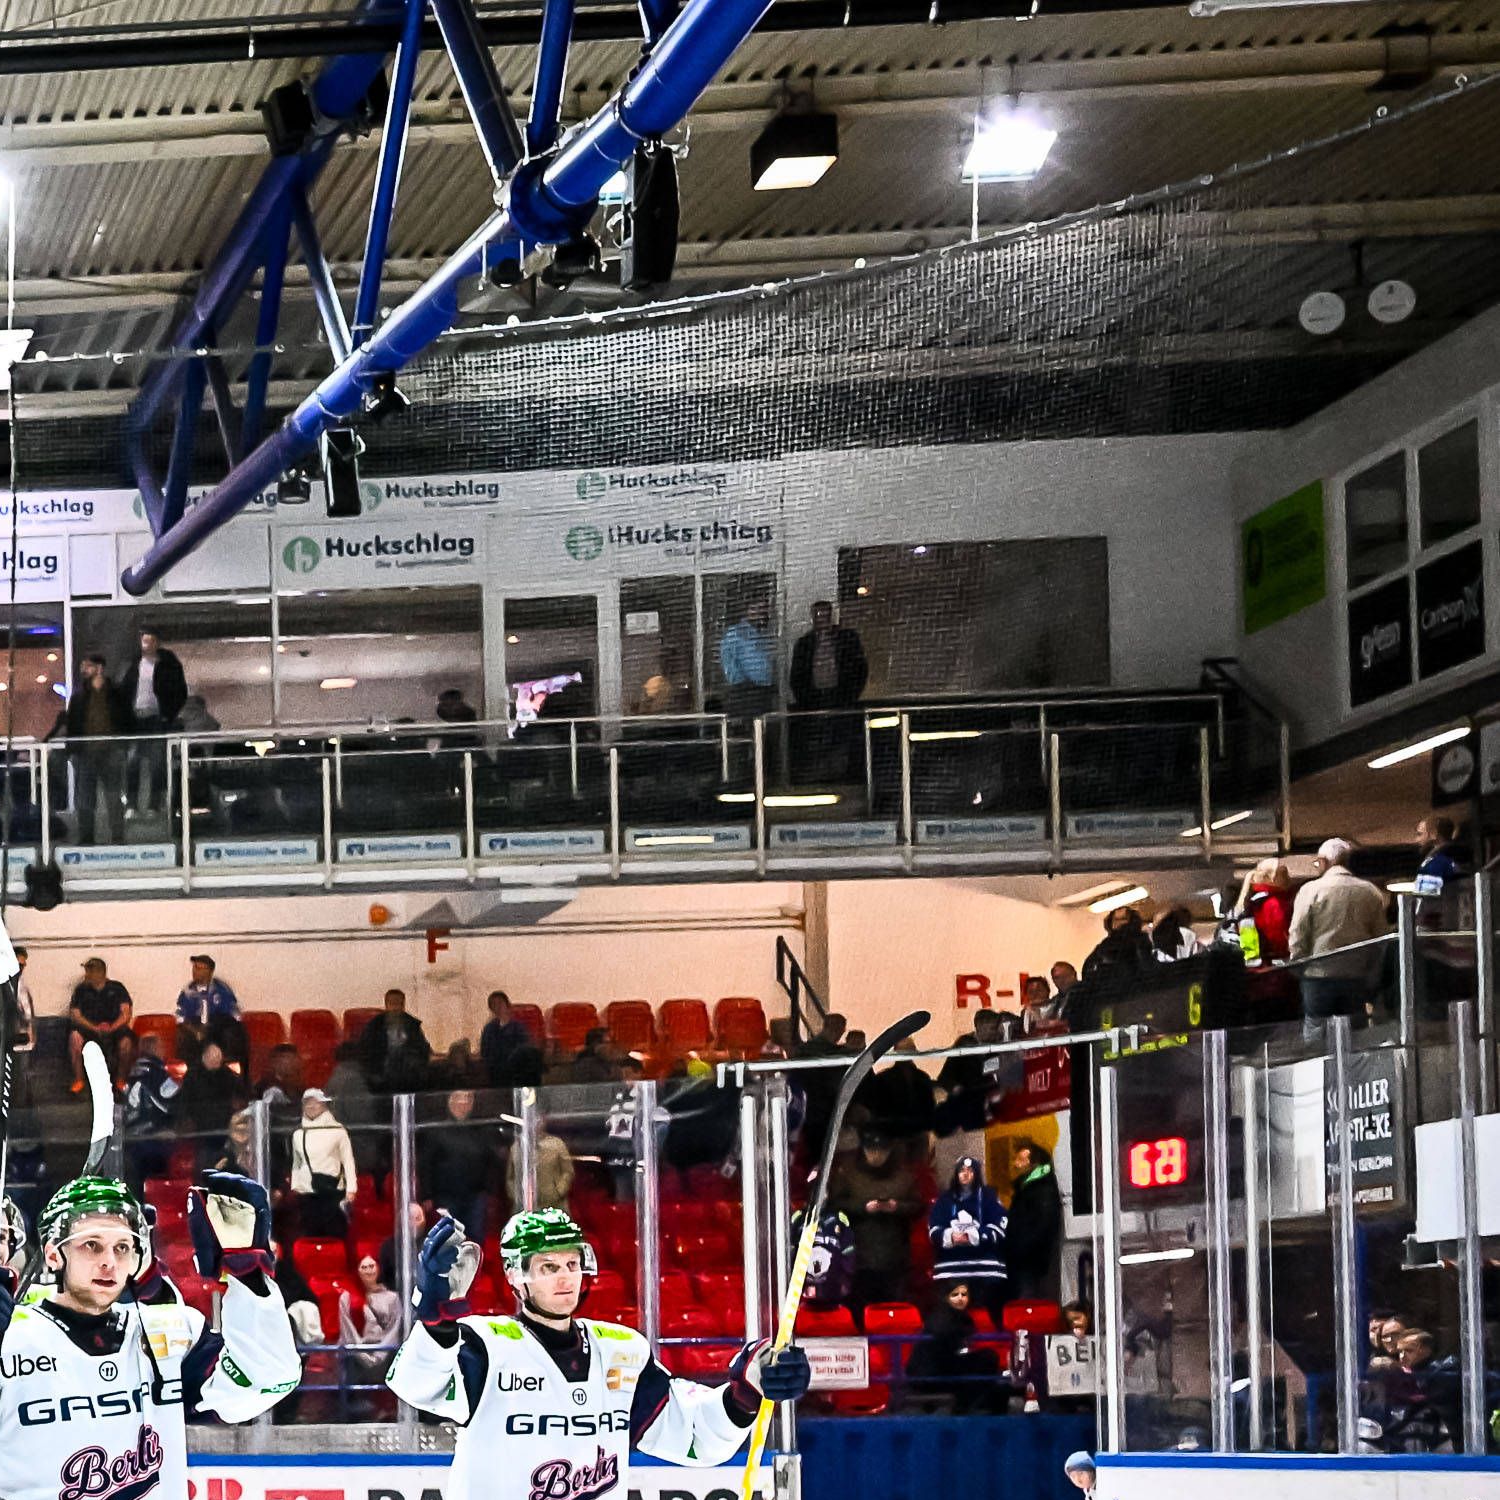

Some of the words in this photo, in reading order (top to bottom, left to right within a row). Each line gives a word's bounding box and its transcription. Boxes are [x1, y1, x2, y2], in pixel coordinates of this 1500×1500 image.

[385, 480, 499, 500] Huckschlag
[325, 532, 475, 559] Huckschlag
[0, 1356, 57, 1380] Uber
[498, 1372, 545, 1392] Uber
